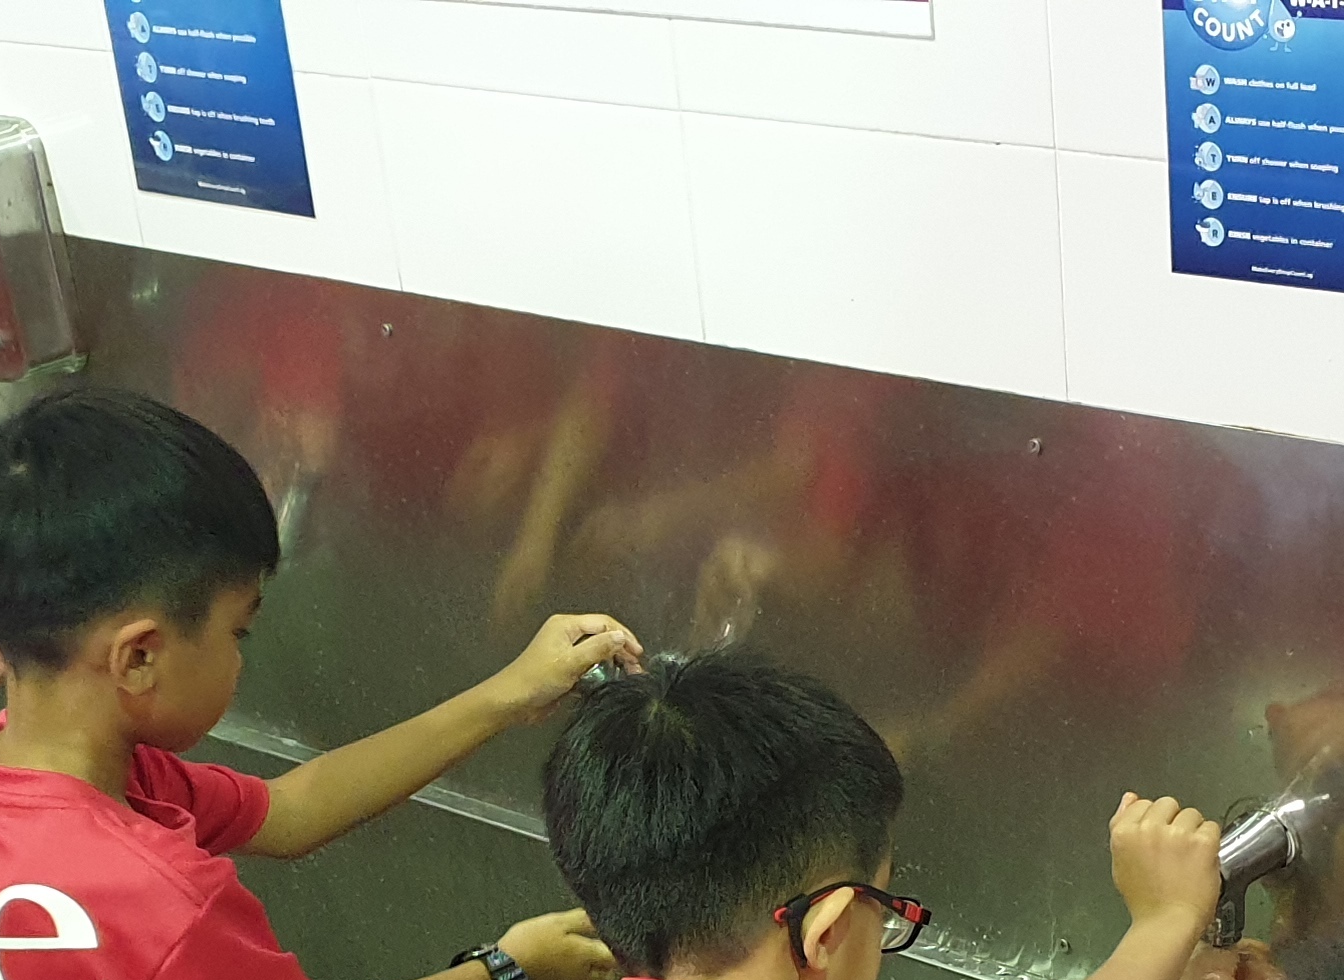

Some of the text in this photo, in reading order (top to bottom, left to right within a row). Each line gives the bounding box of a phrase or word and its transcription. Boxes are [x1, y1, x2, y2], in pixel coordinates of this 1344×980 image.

[1193, 7, 1266, 42] COUNT
[1206, 77, 1215, 87] W
[1209, 115, 1216, 124] A
